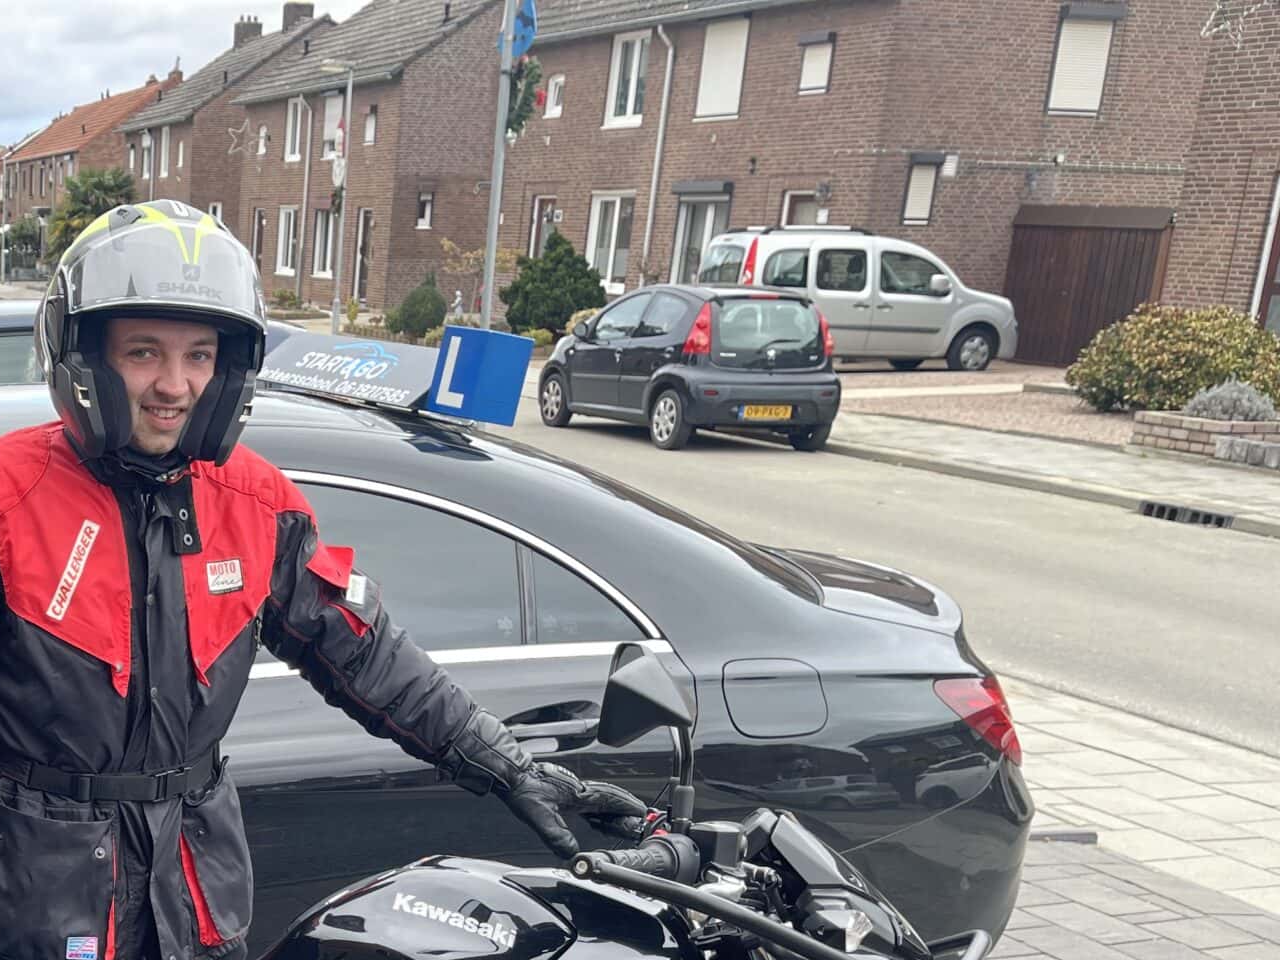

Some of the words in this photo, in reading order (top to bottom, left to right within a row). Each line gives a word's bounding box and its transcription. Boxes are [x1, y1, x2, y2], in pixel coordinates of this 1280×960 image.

[157, 281, 224, 300] SHARK
[436, 335, 464, 409] L
[51, 525, 96, 616] CHALLENGER
[209, 561, 236, 576] MOTO
[392, 892, 518, 949] Kawasaki
